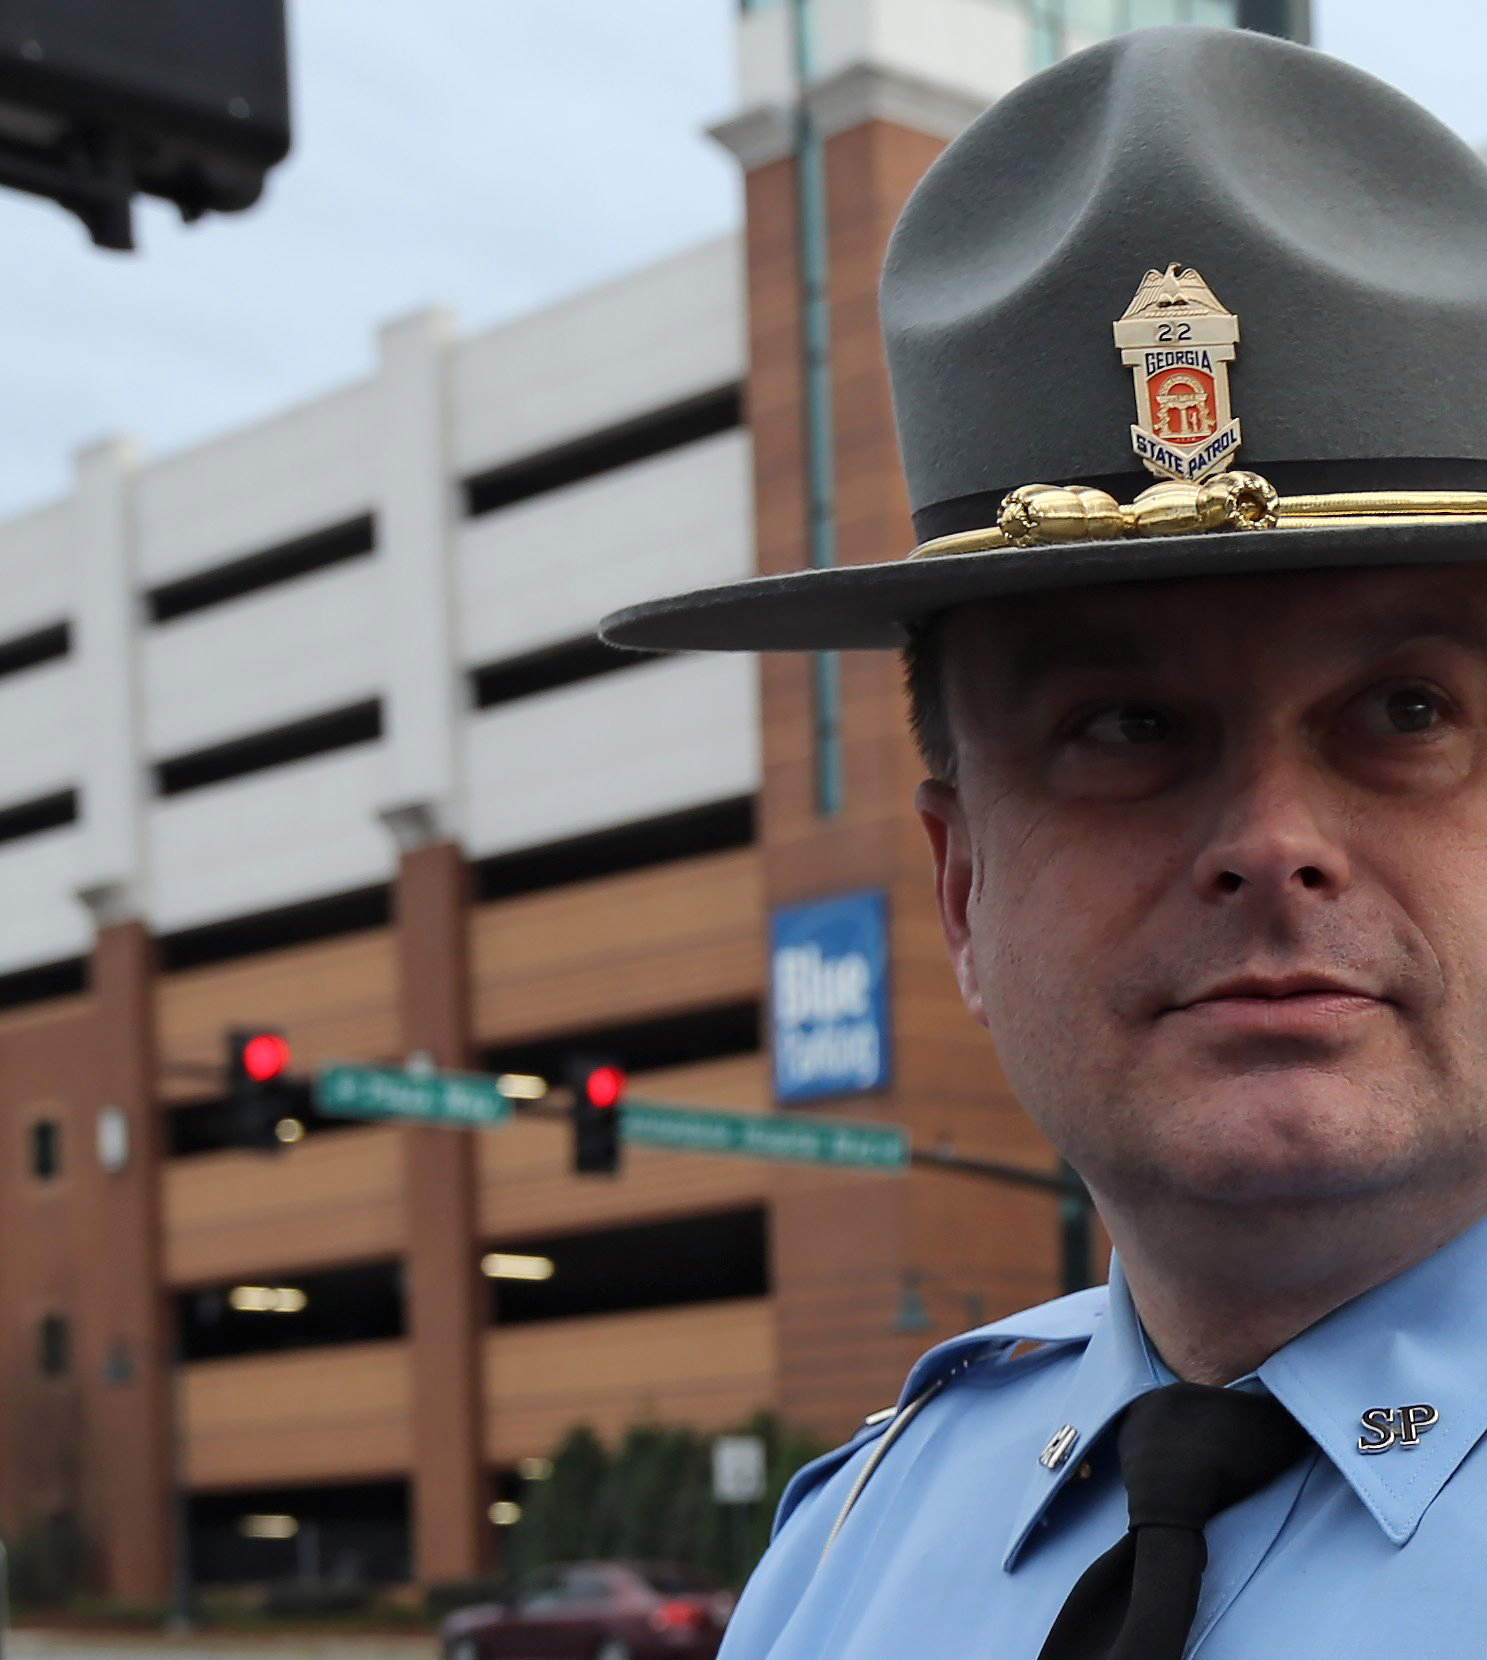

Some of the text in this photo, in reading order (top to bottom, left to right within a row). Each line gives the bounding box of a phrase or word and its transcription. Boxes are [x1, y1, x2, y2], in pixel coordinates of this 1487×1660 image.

[1157, 322, 1193, 343] 22
[1145, 350, 1212, 376] GEORGIA
[1136, 428, 1239, 477] STATE PATROL
[774, 942, 871, 1030] Blue
[1357, 1403, 1440, 1456] SP
